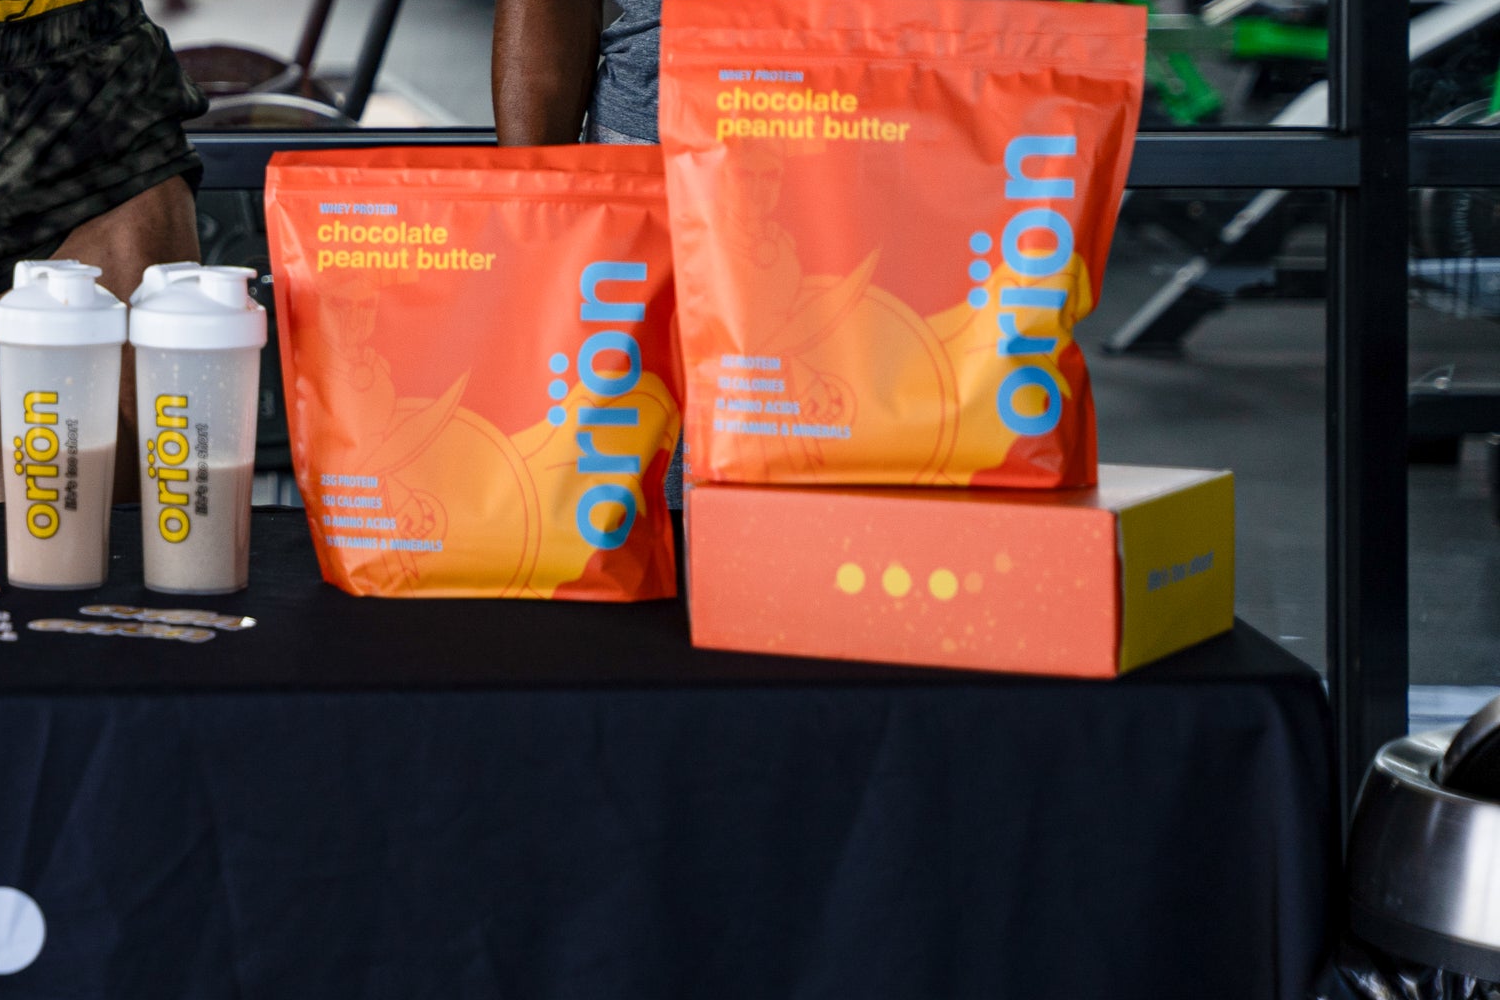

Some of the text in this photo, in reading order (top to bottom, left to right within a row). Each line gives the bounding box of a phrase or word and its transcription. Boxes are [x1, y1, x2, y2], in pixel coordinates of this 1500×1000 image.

[716, 86, 859, 113] chocolate
[716, 115, 911, 143] peanut butter
[352, 203, 398, 215] PROTEIN
[317, 220, 448, 245] chocolate
[317, 247, 496, 272] peanut butter
[65, 418, 78, 455] short
[194, 423, 208, 459] short
[338, 475, 378, 488] PROTEIN
[337, 496, 382, 509] CALORIES
[366, 518, 396, 530] ACIDS
[389, 539, 443, 552] MINERALS
